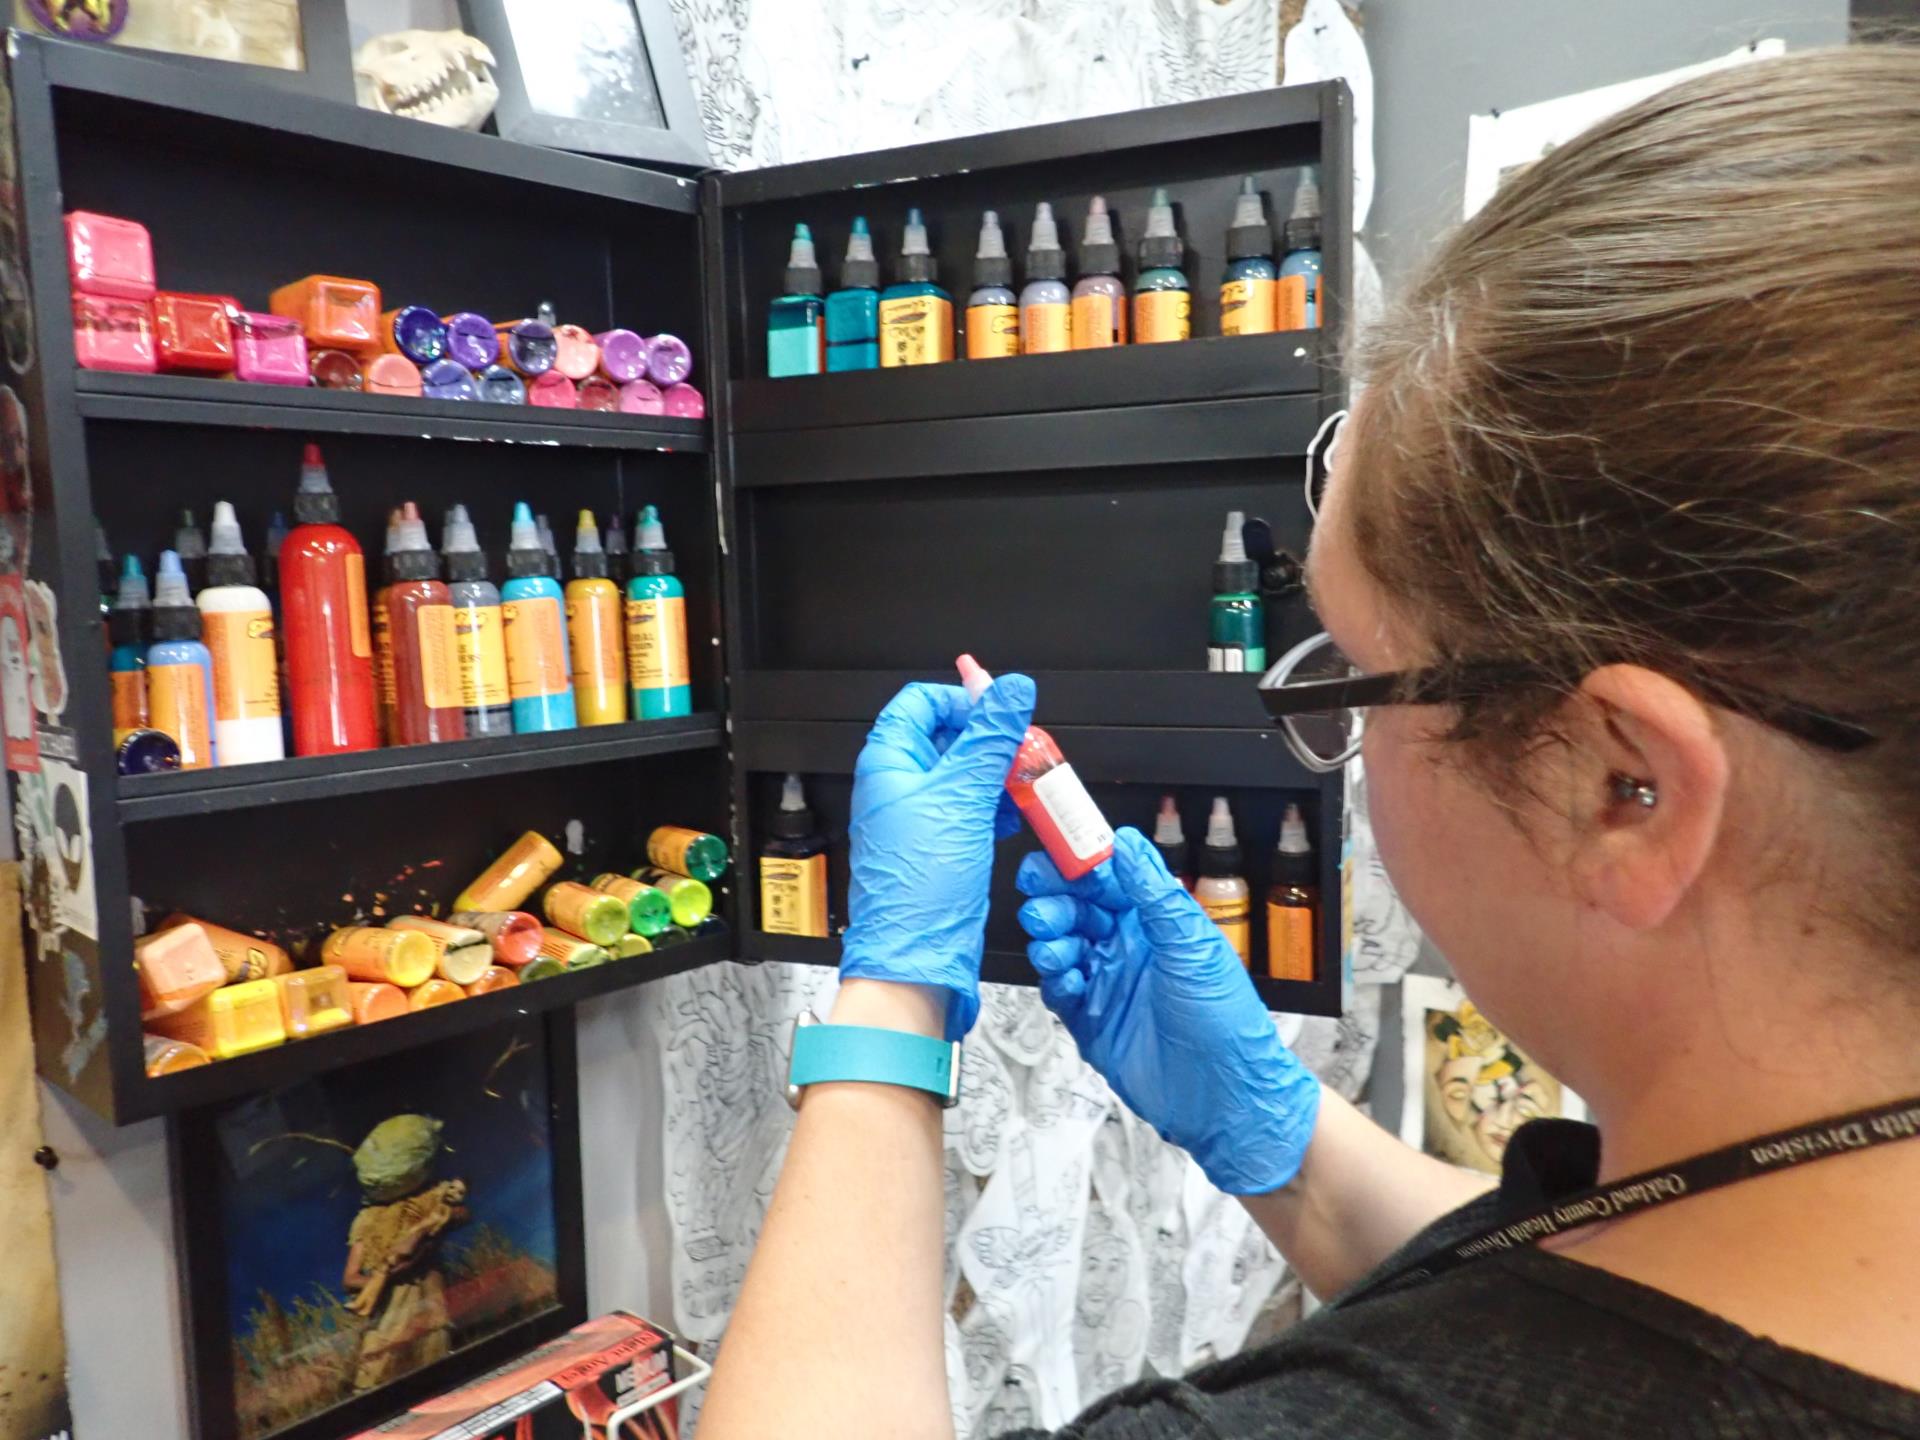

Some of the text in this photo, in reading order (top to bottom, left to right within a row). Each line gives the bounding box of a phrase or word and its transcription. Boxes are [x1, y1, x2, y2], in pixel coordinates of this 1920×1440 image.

[1750, 1122, 1869, 1164] Division
[1456, 1173, 1686, 1259] Oakland County Health Division
